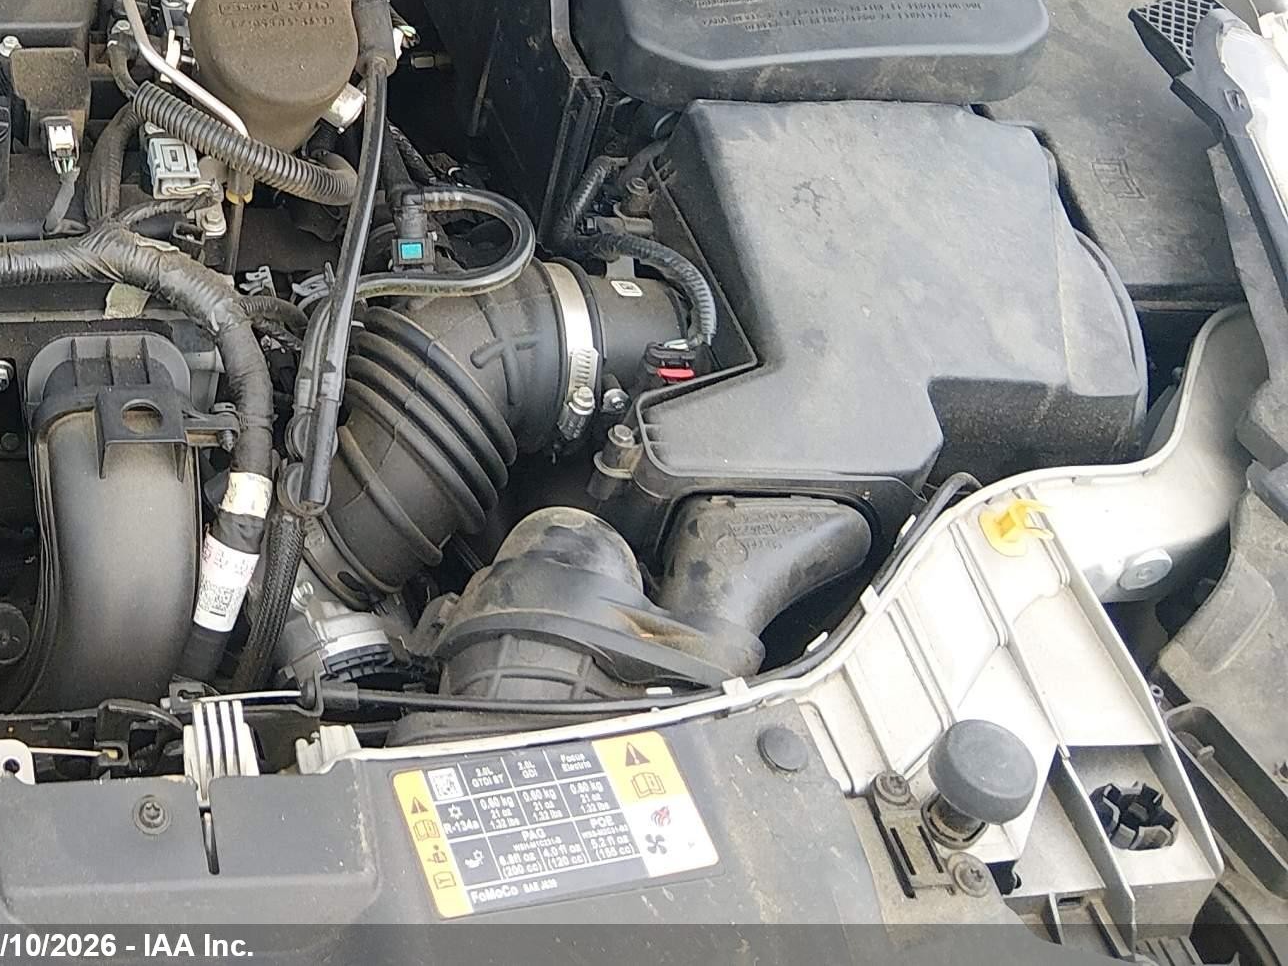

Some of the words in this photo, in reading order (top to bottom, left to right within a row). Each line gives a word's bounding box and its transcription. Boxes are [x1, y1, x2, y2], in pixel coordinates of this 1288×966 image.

[517, 760, 535, 771] 2.0L
[475, 767, 493, 777] 2.0L
[570, 782, 588, 793] 0.60
[588, 780, 604, 792] kg
[522, 791, 542, 803] 0.60
[543, 788, 558, 801] kg
[580, 793, 591, 803] 21
[592, 792, 602, 802] oz
[480, 798, 500, 811] 0.60
[500, 795, 515, 808] kg
[533, 802, 543, 812] 21
[544, 800, 555, 810] oz
[580, 802, 598, 814] 1.32
[490, 809, 501, 819] 21
[503, 808, 512, 817] oz
[532, 811, 550, 822] 1.32
[443, 818, 480, 835] R-134a
[490, 819, 508, 830] 1.32
[590, 814, 614, 829] POE
[521, 828, 547, 841] PAG
[617, 835, 629, 844] oz
[543, 846, 558, 858] 4.0
[569, 843, 582, 853] oz
[618, 844, 634, 856] cc)
[527, 861, 542, 874] cc)
[548, 856, 569, 871] (120
[571, 852, 588, 864] cc)
[470, 884, 519, 904] FoMoCo
[522, 881, 540, 894] SAE
